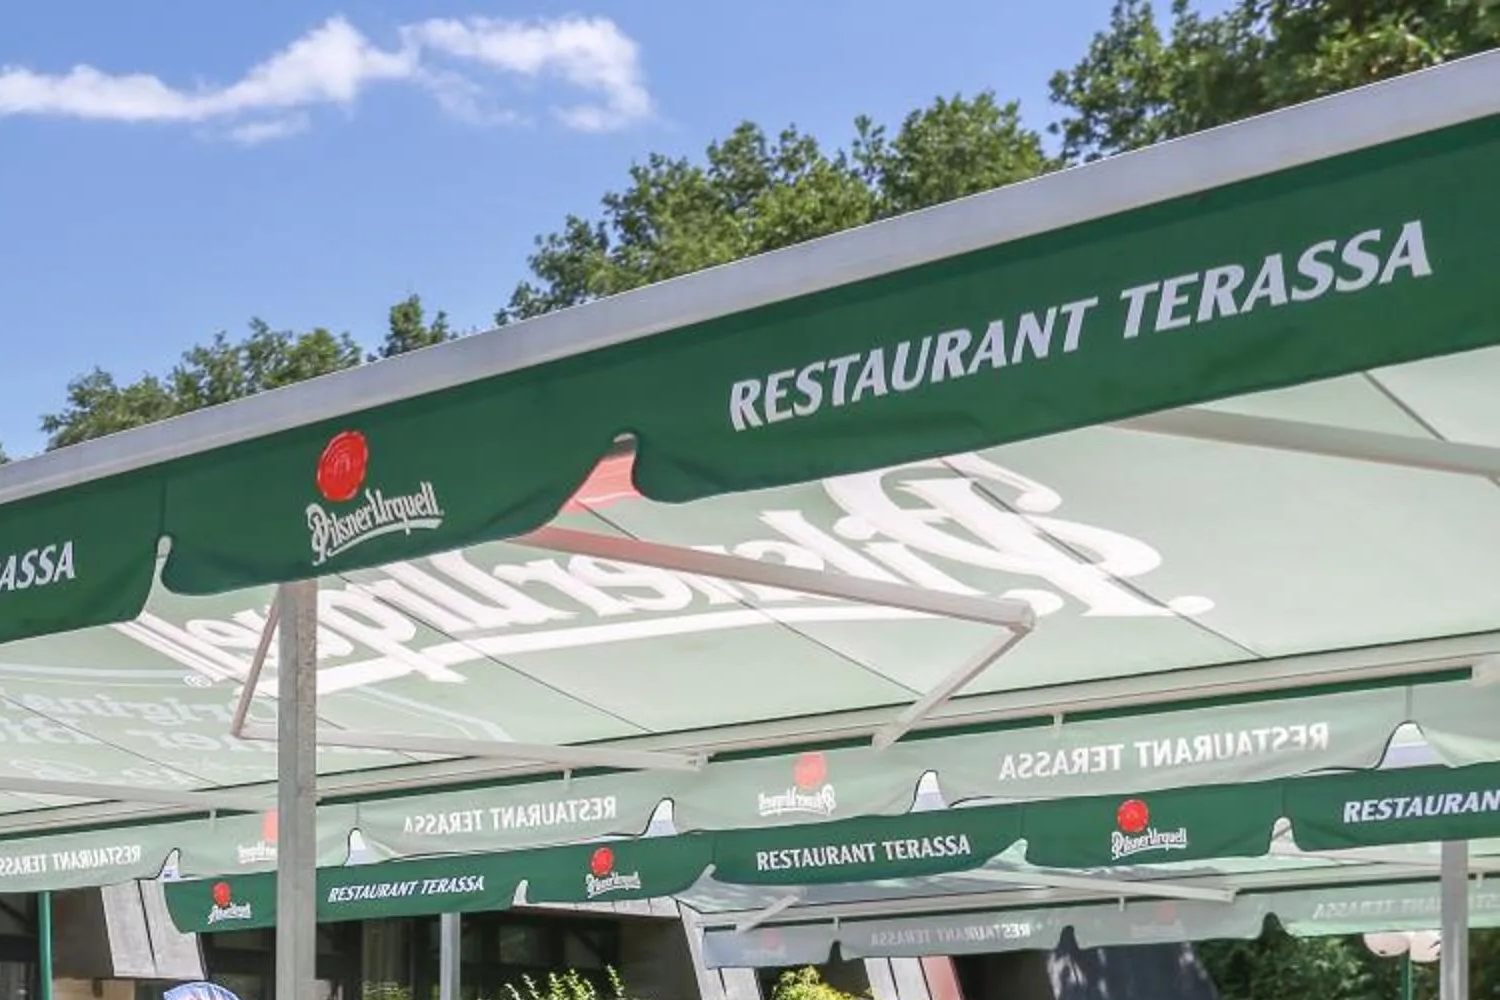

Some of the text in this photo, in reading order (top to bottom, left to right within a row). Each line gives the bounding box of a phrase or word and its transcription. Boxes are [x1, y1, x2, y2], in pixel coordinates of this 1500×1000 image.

[729, 219, 1432, 430] RESTAURANT TERASSA
[755, 834, 972, 872] RESTAURANT TERASSA
[328, 876, 485, 903] RESTAURANT TERASSA
